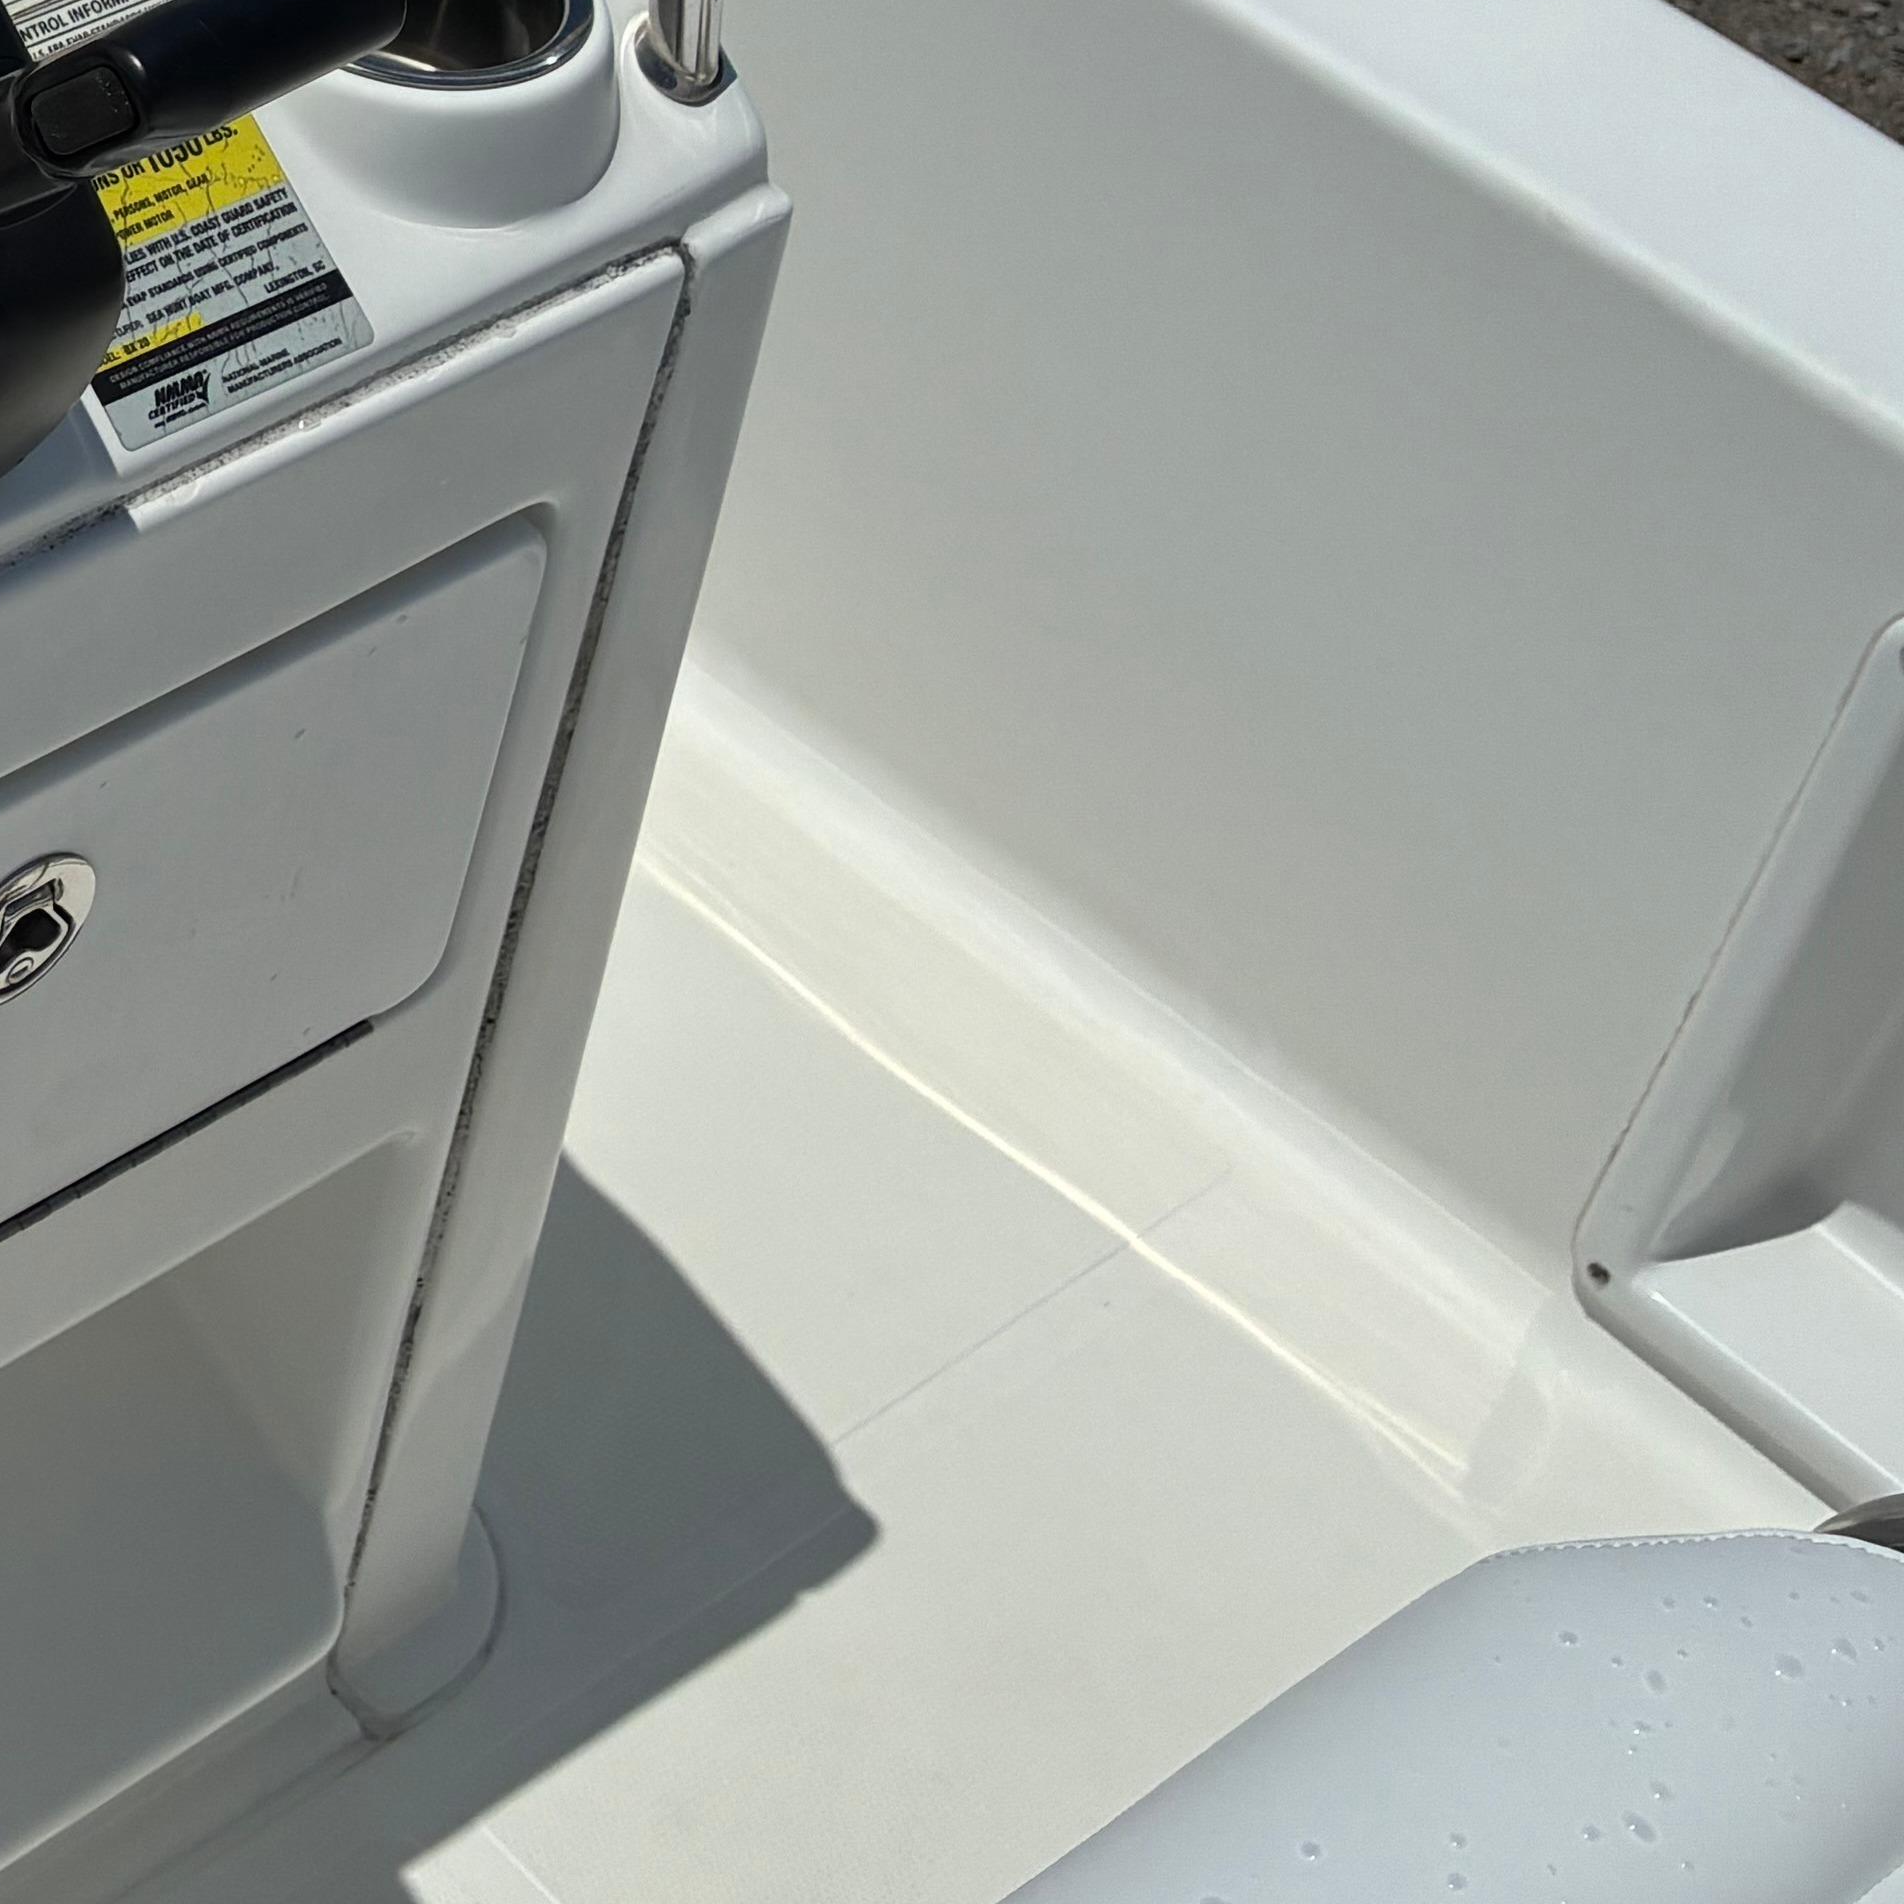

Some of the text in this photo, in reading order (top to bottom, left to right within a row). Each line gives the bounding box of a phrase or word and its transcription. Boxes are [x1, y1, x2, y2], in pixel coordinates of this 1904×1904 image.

[15, 14, 69, 44] NTROL
[202, 123, 238, 146] LBS.
[153, 184, 187, 203] MOTOR,
[123, 248, 147, 265] LIES
[145, 237, 172, 256] WITH
[190, 215, 221, 237] COAST
[221, 202, 254, 224] GUARD
[253, 187, 288, 210] SAFETY
[143, 210, 175, 229] MOTOR
[124, 202, 298, 284] EFFECT ON THE DATE OF CERTIFICATION
[148, 389, 199, 420] CERTIFIED
